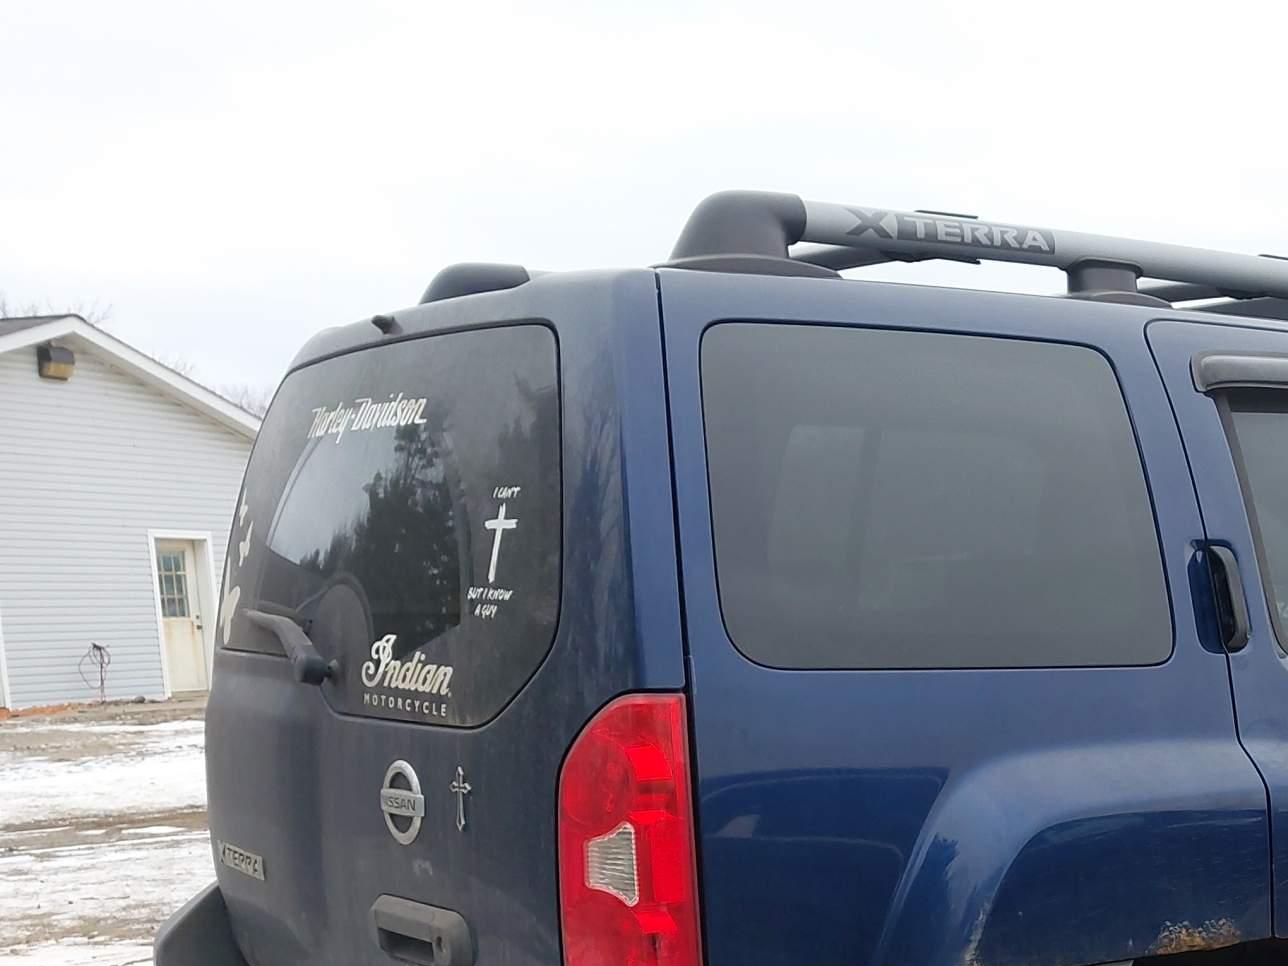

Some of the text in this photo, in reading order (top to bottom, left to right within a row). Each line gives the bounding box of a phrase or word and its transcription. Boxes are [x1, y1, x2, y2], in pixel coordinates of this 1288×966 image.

[845, 207, 1051, 251] XTERRA
[307, 392, 427, 444] Harley-Davidson
[467, 586, 484, 600] BUT
[487, 588, 513, 601] KNOW
[474, 603, 481, 617] A
[363, 692, 447, 717] MOTORCYCLE
[383, 795, 416, 811] SSAN
